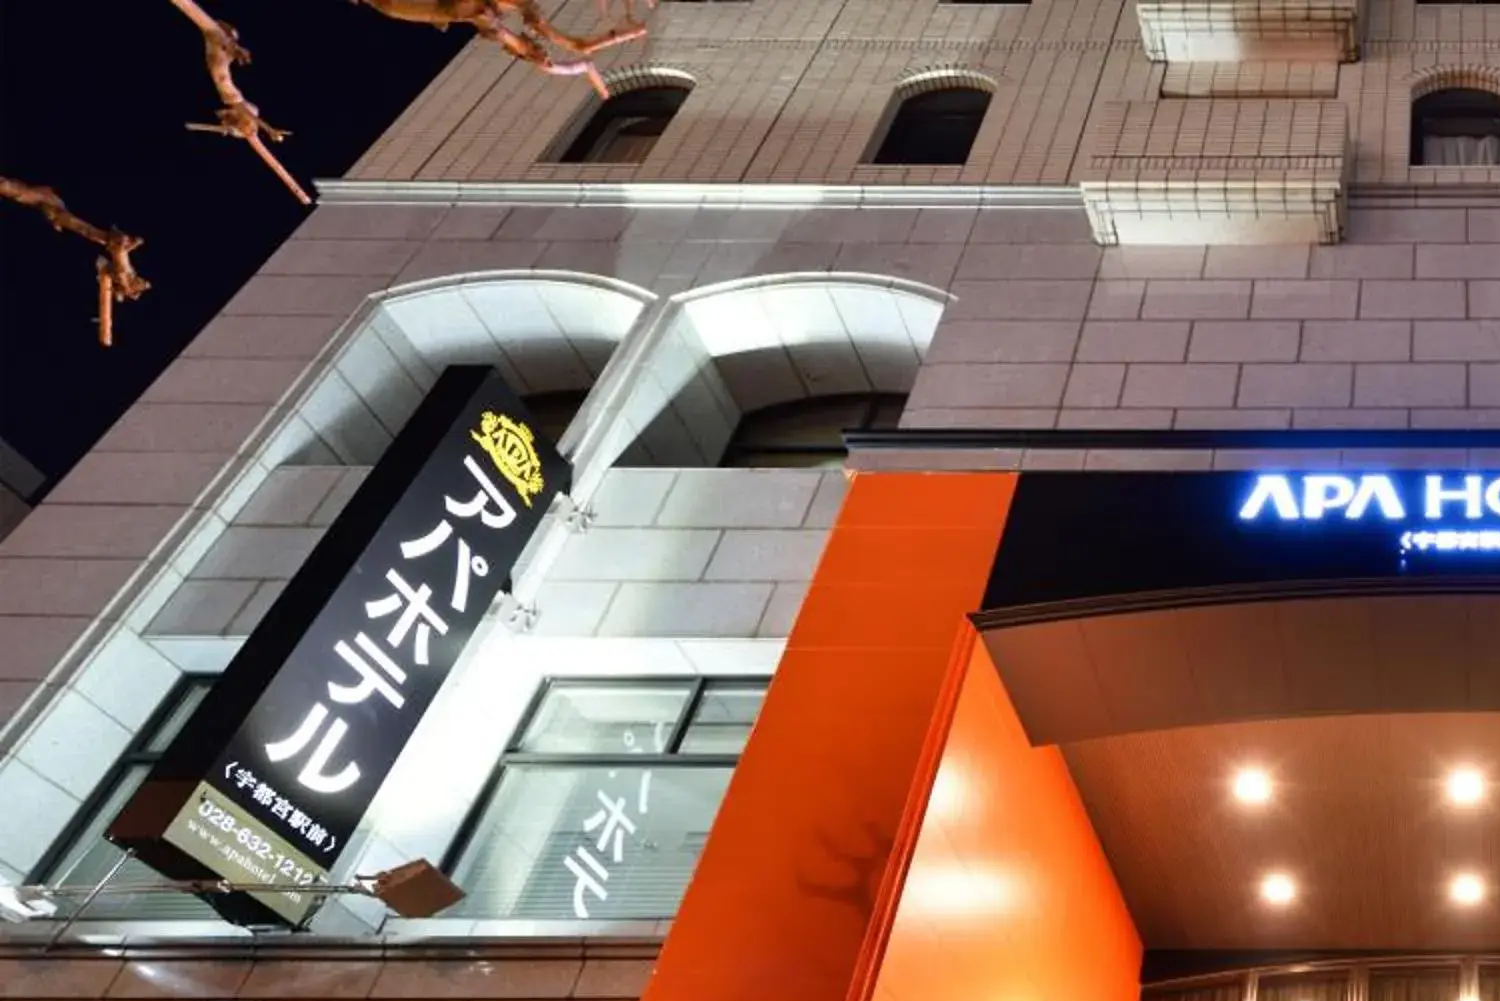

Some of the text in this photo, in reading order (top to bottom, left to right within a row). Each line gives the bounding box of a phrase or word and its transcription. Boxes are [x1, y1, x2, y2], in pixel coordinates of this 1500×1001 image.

[1239, 473, 1405, 520] APA
[265, 454, 517, 793] アパホテル
[198, 800, 314, 886] 028-632-1212
